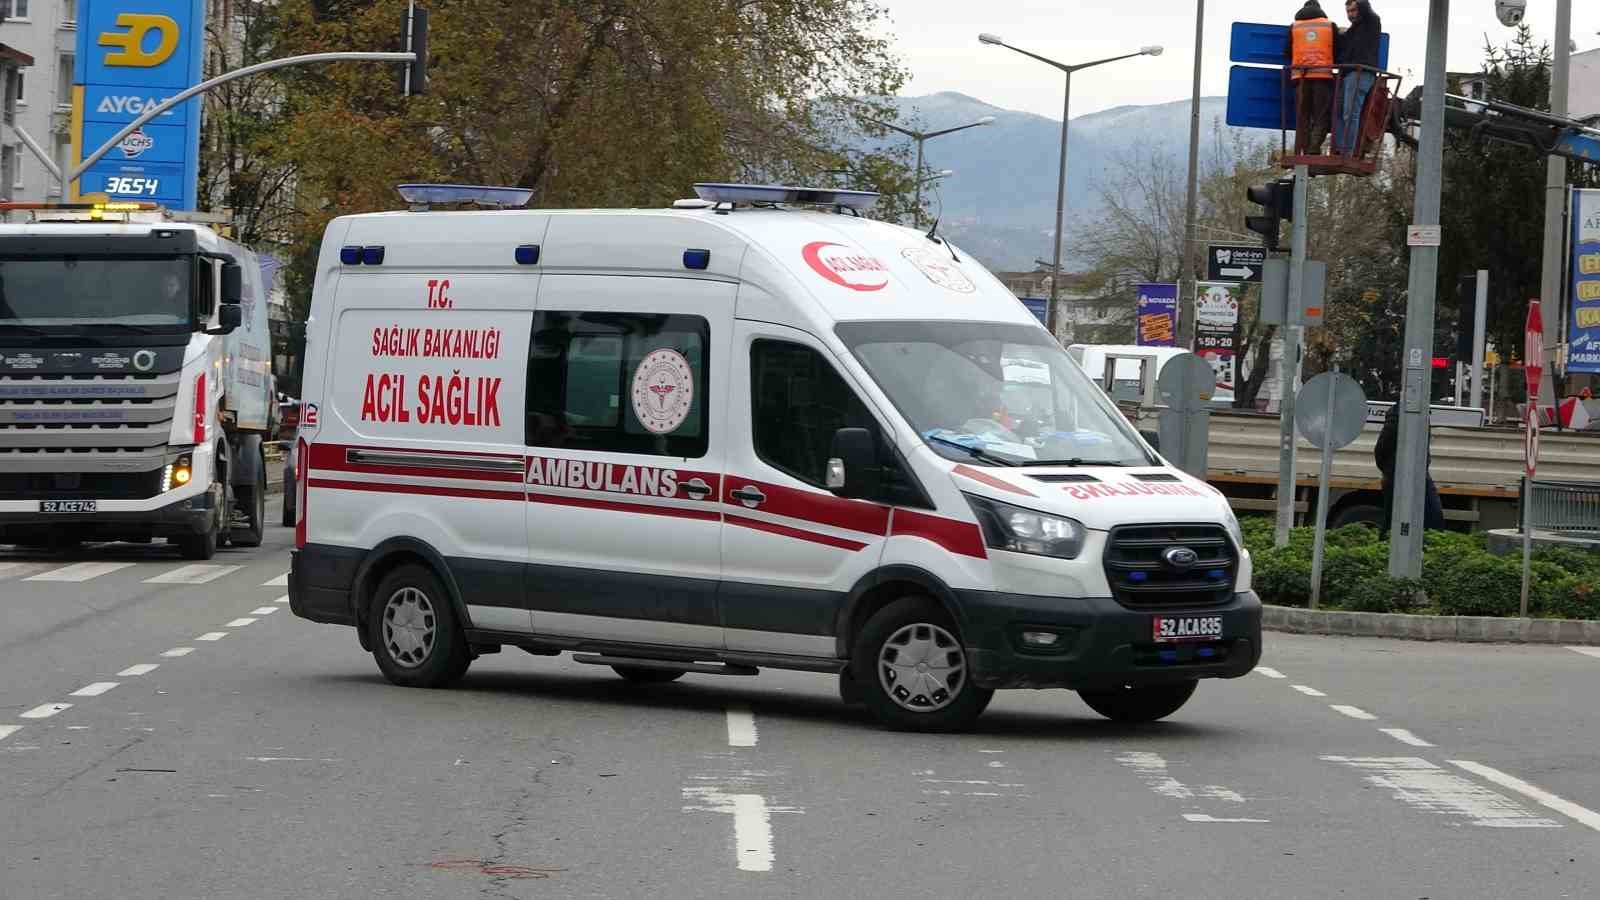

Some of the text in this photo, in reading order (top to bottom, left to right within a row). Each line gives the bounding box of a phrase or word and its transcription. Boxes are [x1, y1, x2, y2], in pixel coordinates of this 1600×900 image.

[427, 279, 452, 308] T.C.
[372, 324, 501, 360] SAĞLIK BAKANLIĞI
[417, 369, 502, 427] SAĞLIK
[526, 458, 678, 498] AMBULANS
[43, 502, 57, 512] 52
[1160, 617, 1221, 636] 52 ACA835
